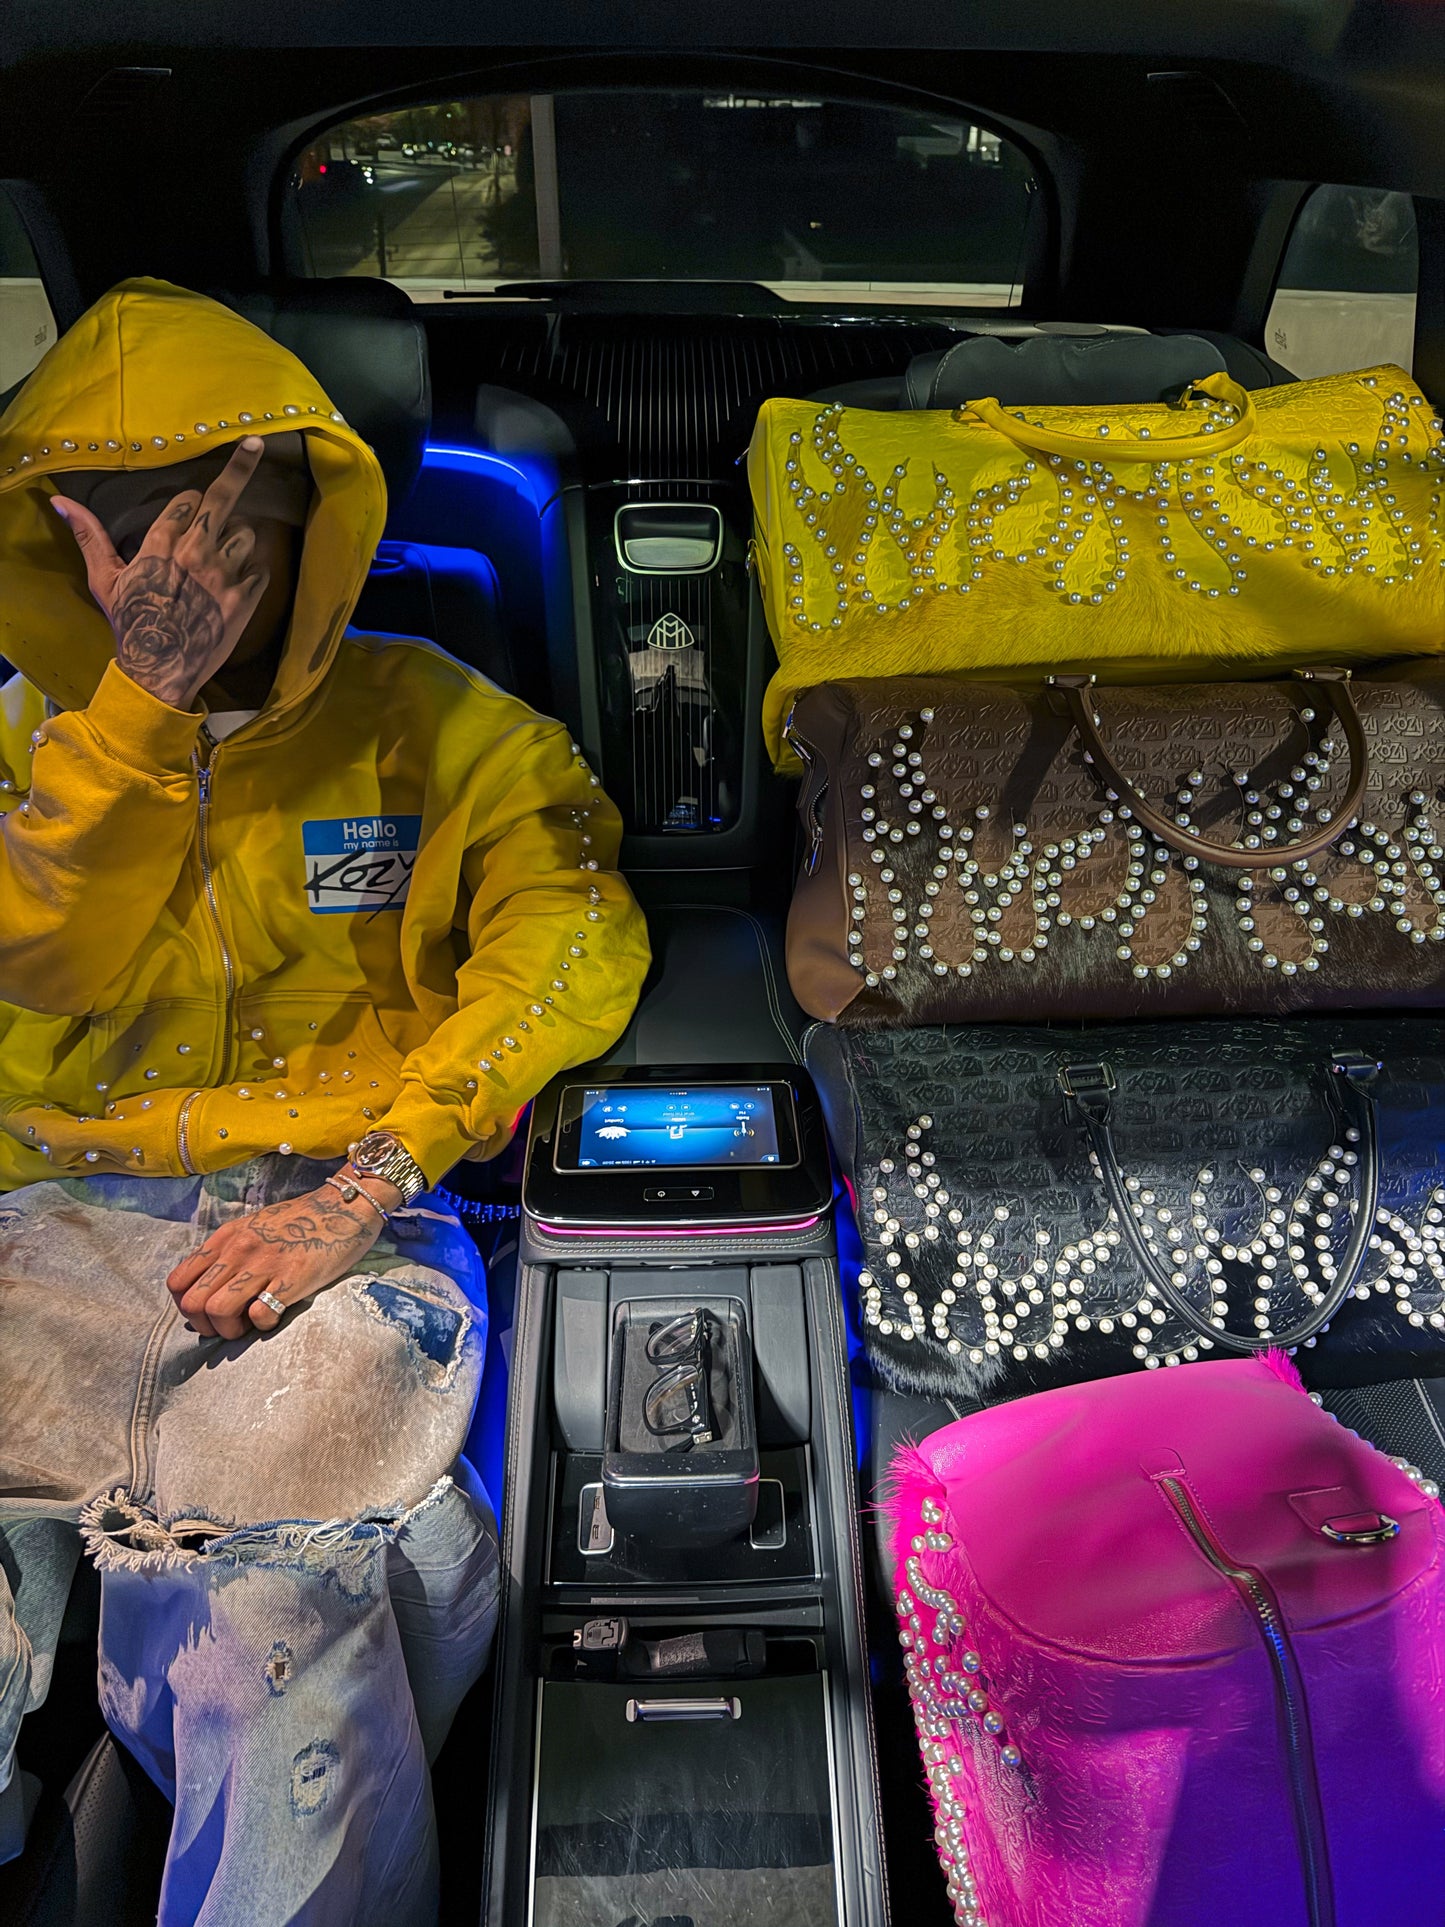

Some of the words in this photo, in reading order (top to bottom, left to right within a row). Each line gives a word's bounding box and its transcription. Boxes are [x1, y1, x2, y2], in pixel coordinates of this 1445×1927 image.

[343, 820, 396, 840] Hello
[343, 842, 359, 851] my
[361, 839, 391, 848] name
[393, 838, 399, 846] is
